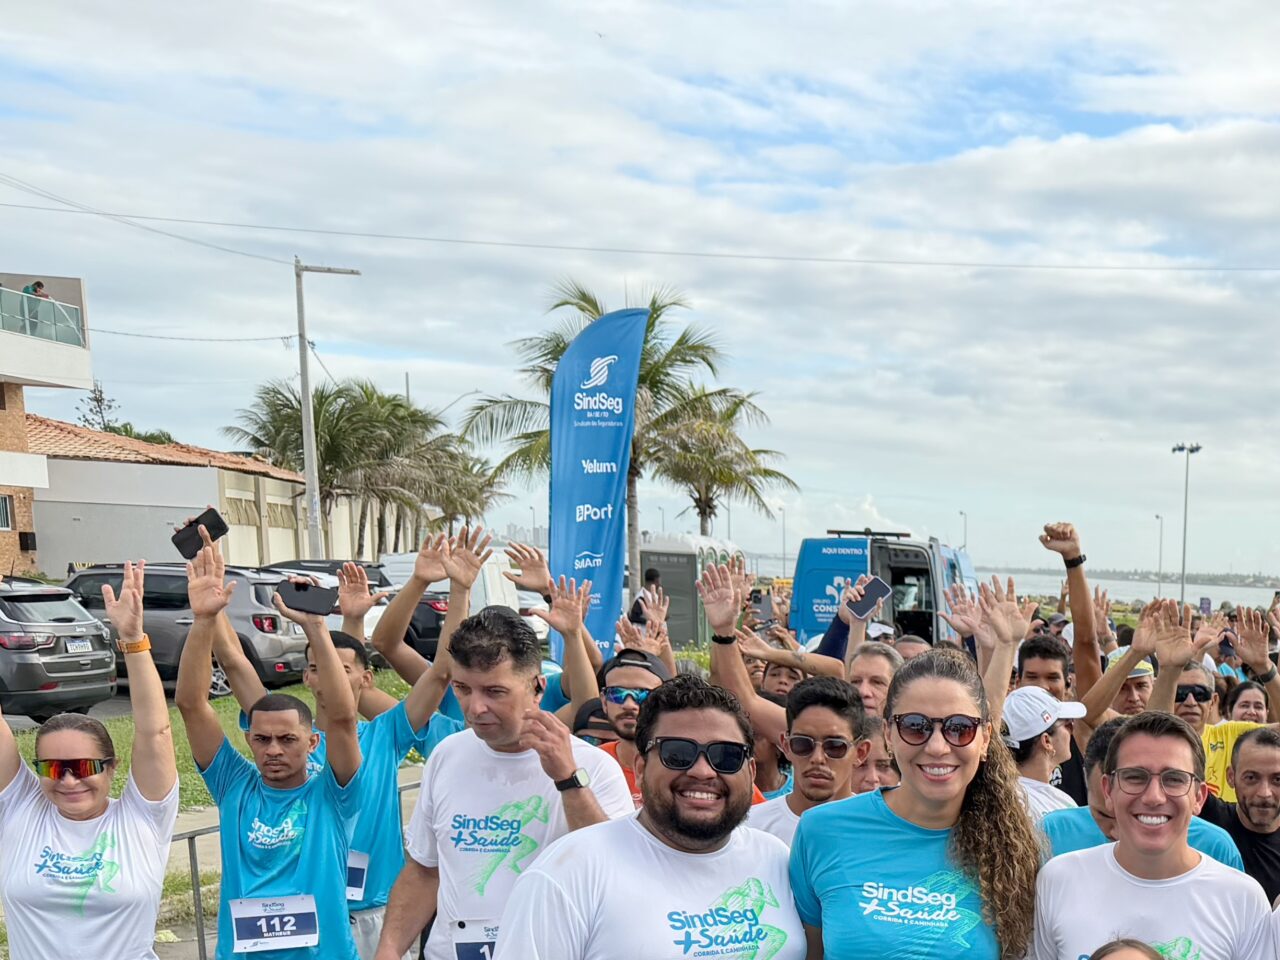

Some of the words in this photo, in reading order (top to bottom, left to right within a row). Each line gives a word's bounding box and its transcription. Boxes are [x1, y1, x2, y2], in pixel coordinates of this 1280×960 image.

[574, 392, 623, 414] SindSeg
[581, 459, 617, 474] Yelum
[813, 604, 839, 613] CONS
[451, 814, 522, 834] SindSeg
[861, 881, 957, 910] SindSeg
[256, 916, 297, 933] 112
[667, 906, 759, 931] SindSeg
[873, 914, 903, 924] CORRIDA
[909, 919, 949, 927] CAMINHADA
[693, 949, 720, 957] CORRIDA
[725, 945, 761, 954] CAMINHADA
